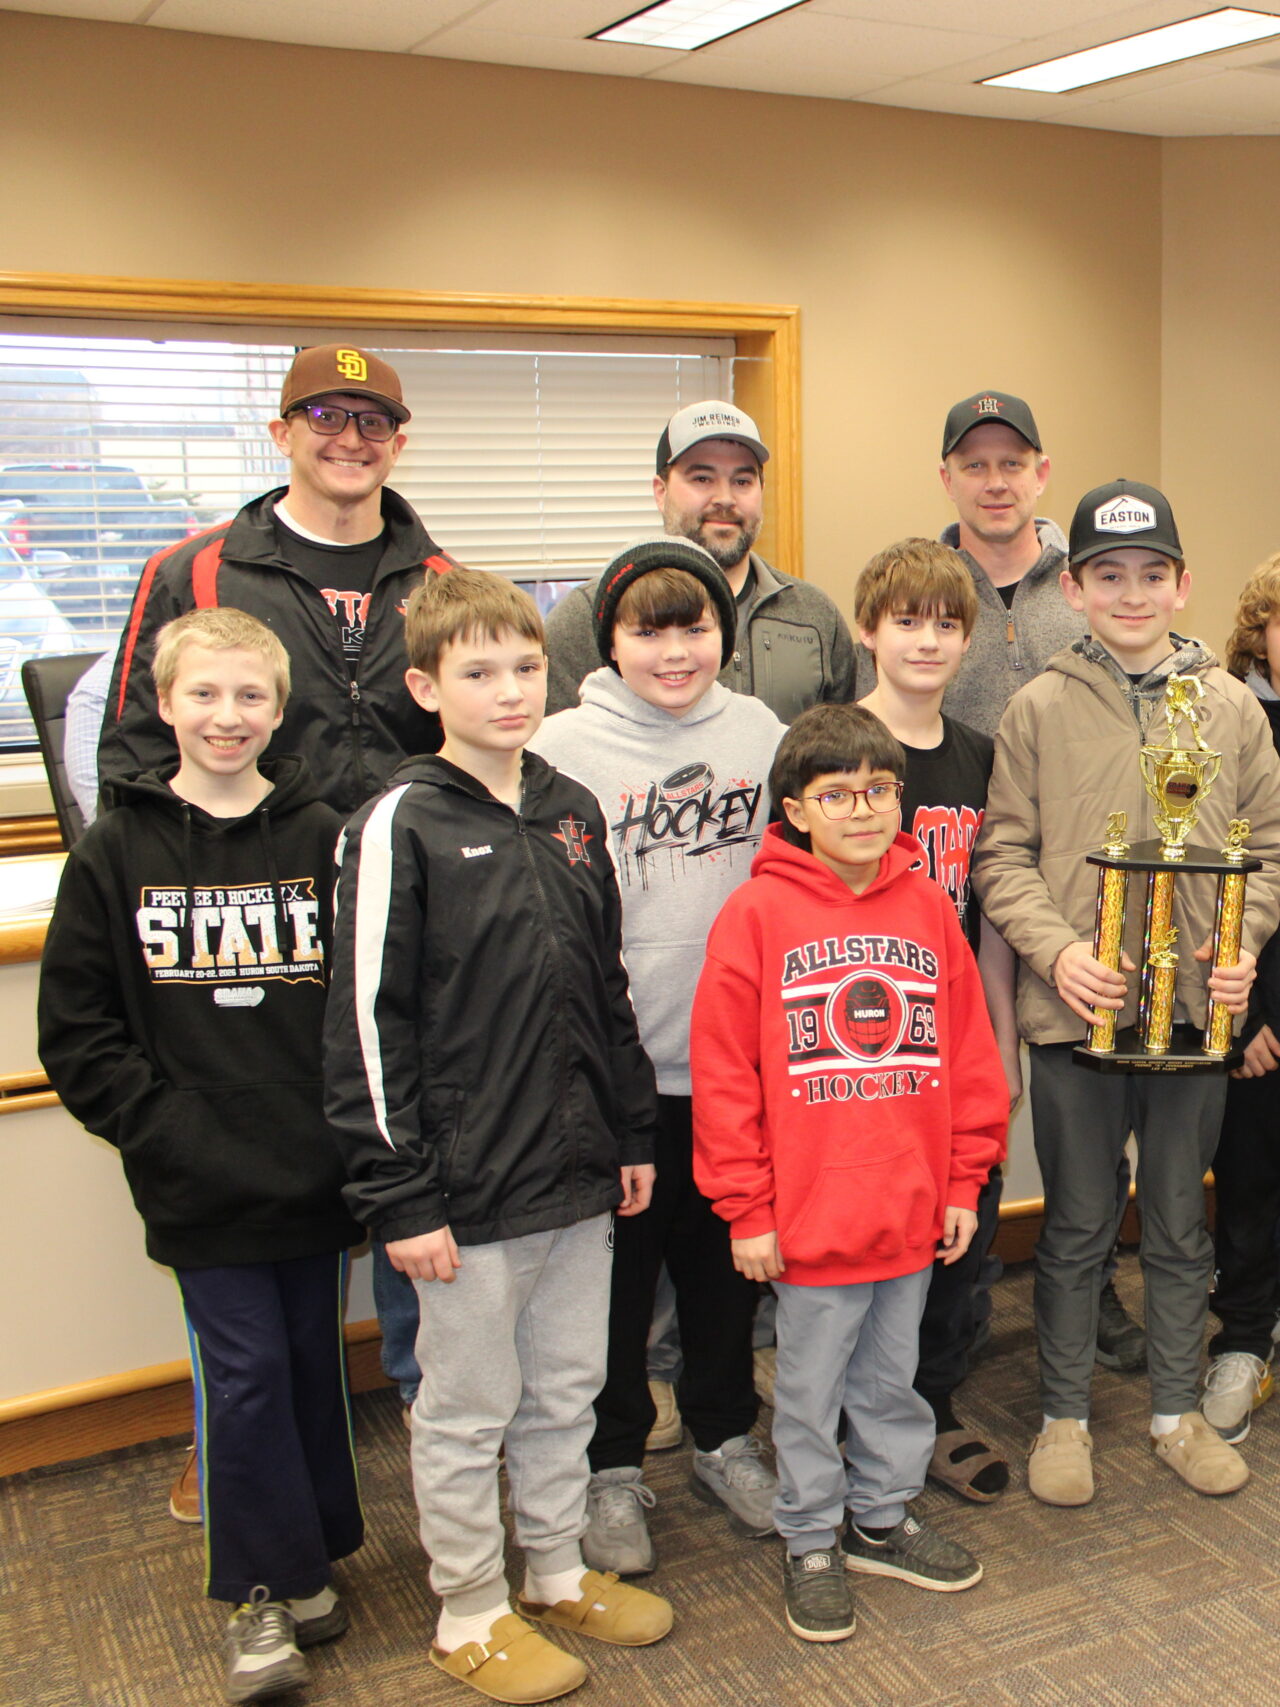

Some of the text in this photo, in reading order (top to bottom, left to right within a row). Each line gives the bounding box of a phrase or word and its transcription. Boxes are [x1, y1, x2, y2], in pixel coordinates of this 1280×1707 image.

[336, 349, 368, 382] SD
[979, 398, 999, 413] H
[693, 415, 707, 425] JIM
[1101, 510, 1150, 525] EASTON
[665, 782, 704, 800] ALLSTARS
[611, 782, 762, 848] HOCKEY
[1106, 810, 1251, 839] 20 26
[461, 845, 493, 858] Knox
[559, 820, 590, 862] H
[215, 889, 225, 906] B
[136, 900, 324, 969] STATE
[155, 969, 194, 978] FEBRUARY
[239, 967, 265, 976] HURON
[265, 966, 288, 975] SOUTH
[289, 963, 319, 973] DAKOTA
[782, 935, 938, 986] ALLSTARS
[853, 1008, 885, 1019] HURON
[786, 1003, 937, 1052] 19 69
[804, 1069, 929, 1105] HOCKEY
